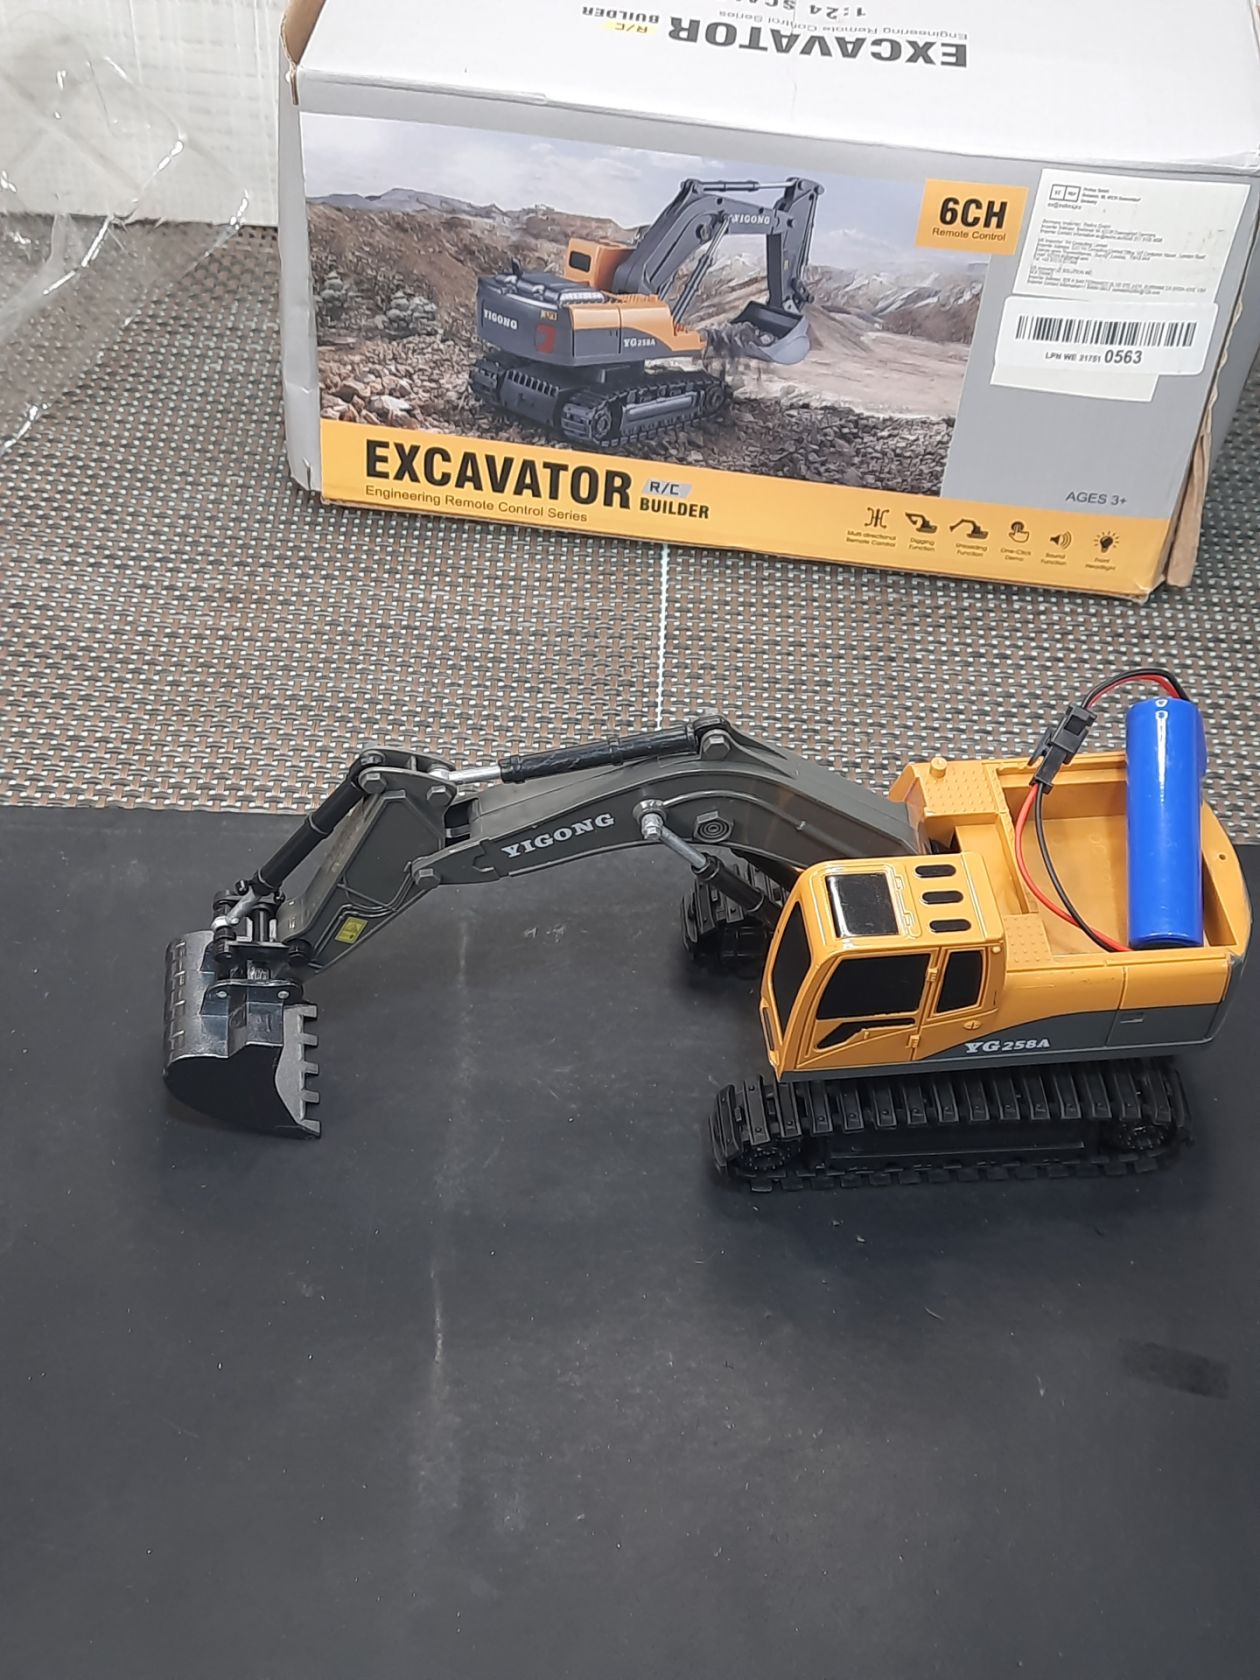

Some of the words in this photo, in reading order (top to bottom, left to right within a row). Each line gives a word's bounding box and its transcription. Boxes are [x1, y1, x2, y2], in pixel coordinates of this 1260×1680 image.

[582, 6, 660, 24] BUILDER
[719, 10, 763, 23] Series
[809, 4, 866, 20] 1:24
[615, 22, 648, 33] R/C
[768, 17, 818, 32] Control
[823, 25, 878, 35] Remote
[883, 26, 967, 41] Engineering
[668, 16, 967, 67] EXCAVATOR
[940, 197, 1008, 229] 6CH
[932, 227, 969, 238] Remote
[972, 231, 1006, 241] Control
[1045, 352, 1062, 360] LPN
[1064, 353, 1077, 361] WE
[1104, 349, 1142, 364] 0563
[366, 439, 632, 510] EXCAVATOR
[650, 481, 680, 496] R/C
[365, 485, 441, 506] Engineering
[445, 494, 494, 510] Remote
[498, 501, 543, 517] Control
[548, 507, 588, 522] Series
[1065, 491, 1107, 504] AGES
[1111, 495, 1127, 506] 3+
[639, 497, 710, 519] BUILDER
[501, 813, 614, 858] YIGONG
[965, 1039, 1050, 1053] YG258A
